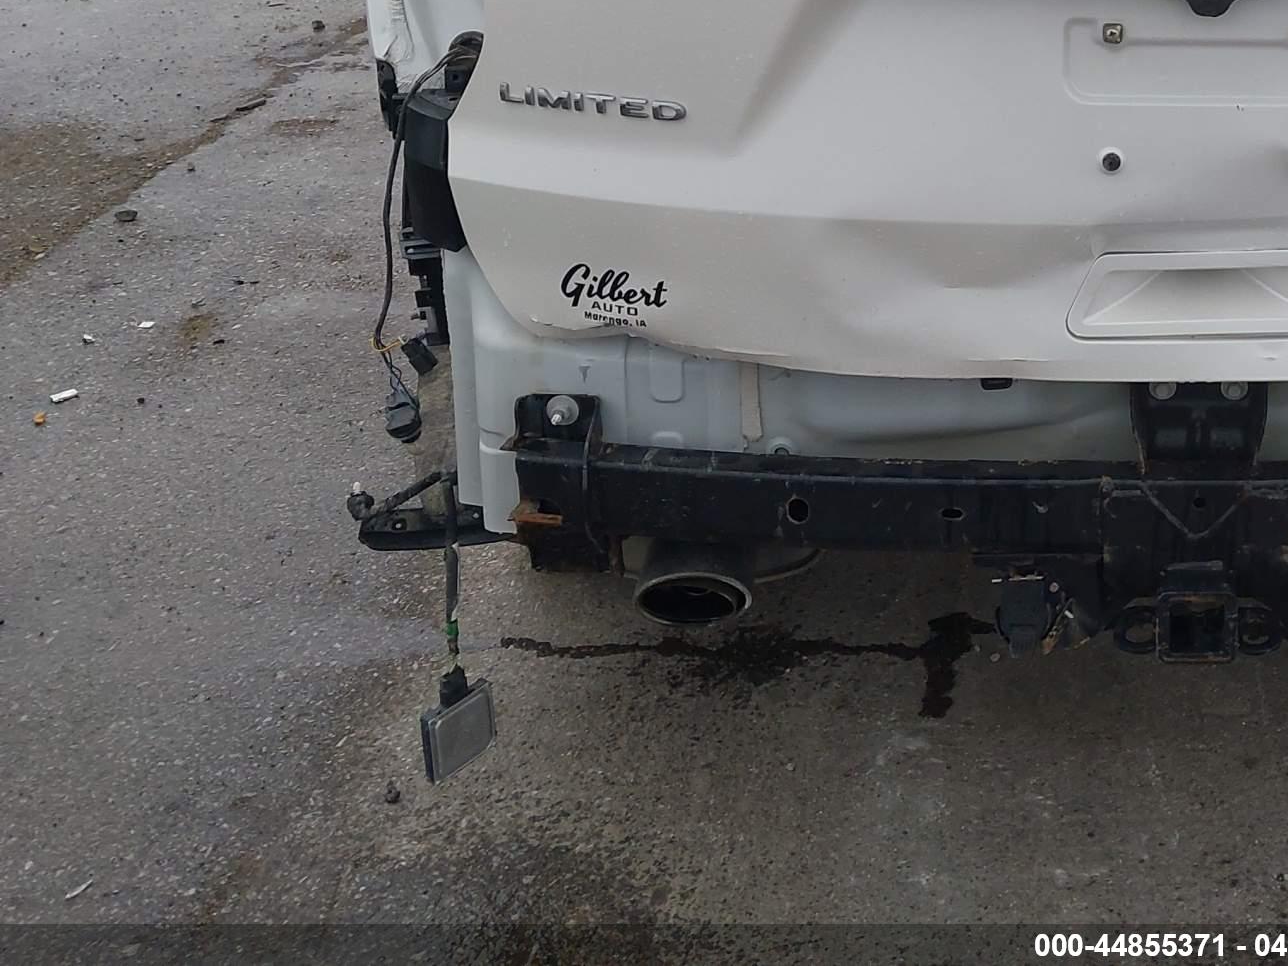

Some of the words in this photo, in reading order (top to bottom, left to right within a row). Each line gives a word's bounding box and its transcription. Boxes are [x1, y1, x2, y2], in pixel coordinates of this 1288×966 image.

[499, 82, 687, 121] LIMITED
[560, 263, 668, 308] Gilbert
[591, 301, 638, 316] AUTO
[635, 318, 647, 327] IA
